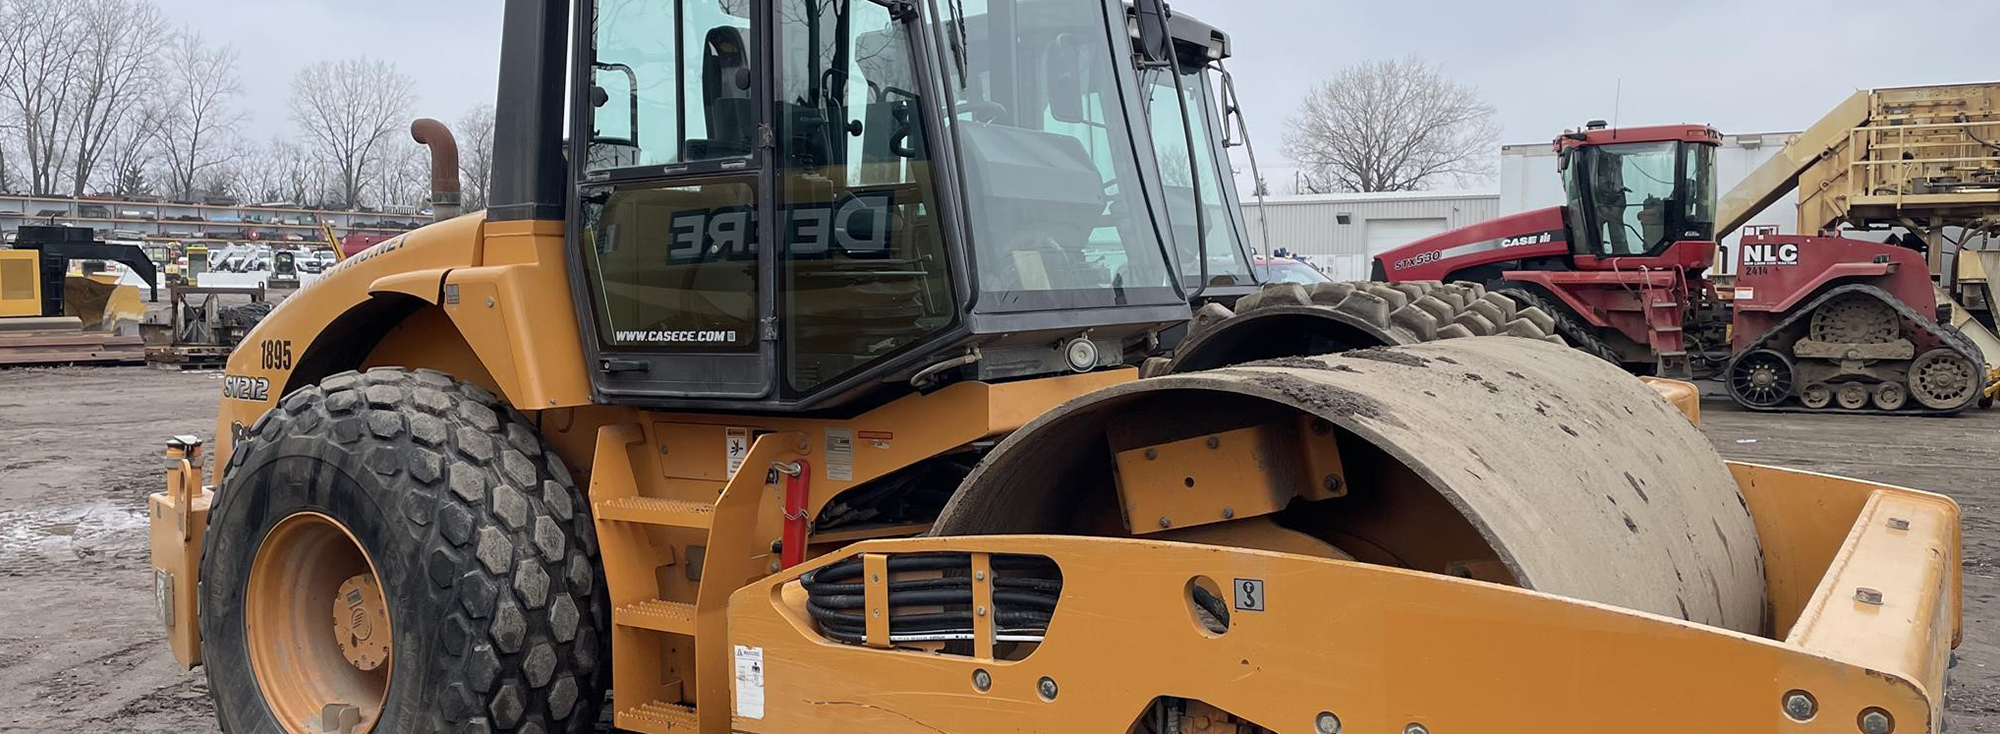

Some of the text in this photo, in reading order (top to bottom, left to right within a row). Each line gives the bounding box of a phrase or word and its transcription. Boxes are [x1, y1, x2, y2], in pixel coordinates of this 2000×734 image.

[1501, 235, 1537, 248] CASE
[1394, 250, 1441, 271] STX530
[1743, 243, 1798, 262] NLC
[1745, 266, 1768, 276] 2414
[615, 330, 726, 342] WWW.CASECE.COM
[260, 339, 292, 371] 1895
[223, 374, 270, 402] SV212
